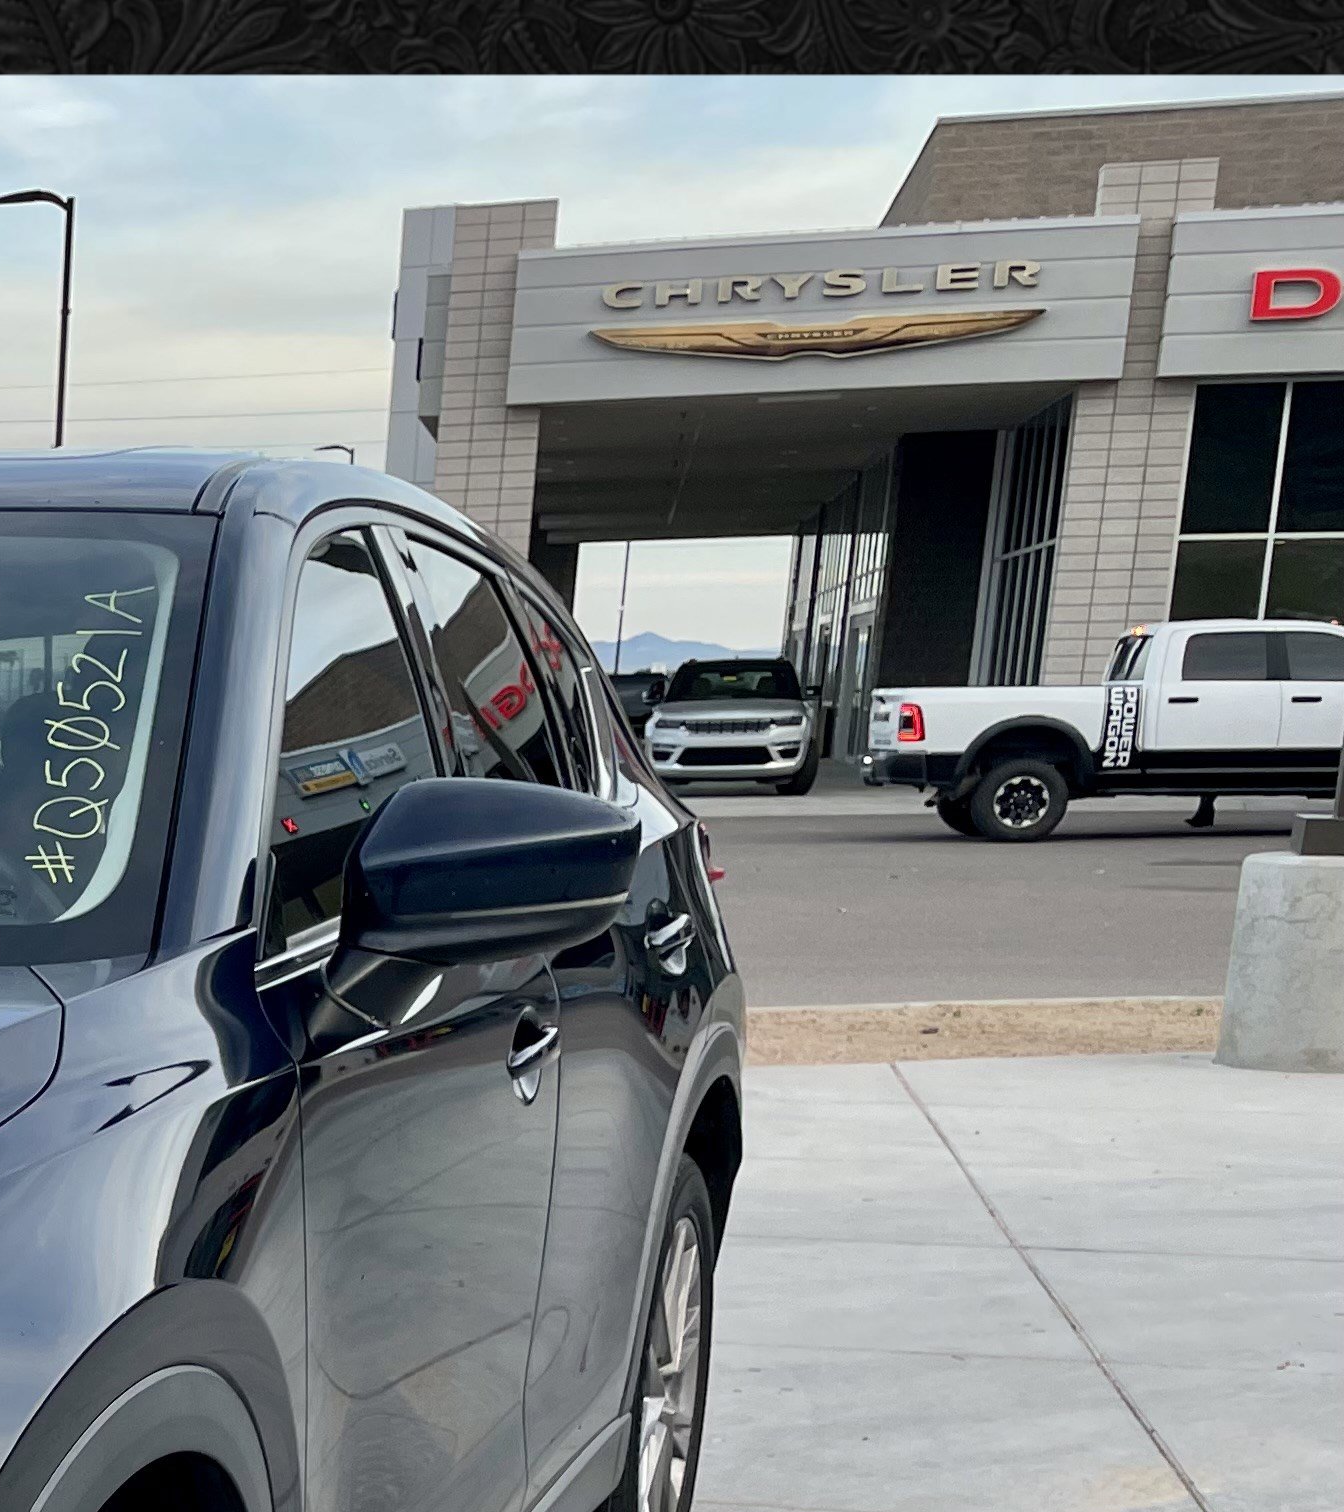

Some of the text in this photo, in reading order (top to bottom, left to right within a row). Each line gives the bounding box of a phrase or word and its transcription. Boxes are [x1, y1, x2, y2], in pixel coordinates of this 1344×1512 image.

[601, 259, 1042, 309] CHRYSLER
[1102, 686, 1124, 768] WAGON
[1116, 686, 1137, 768] POWER
